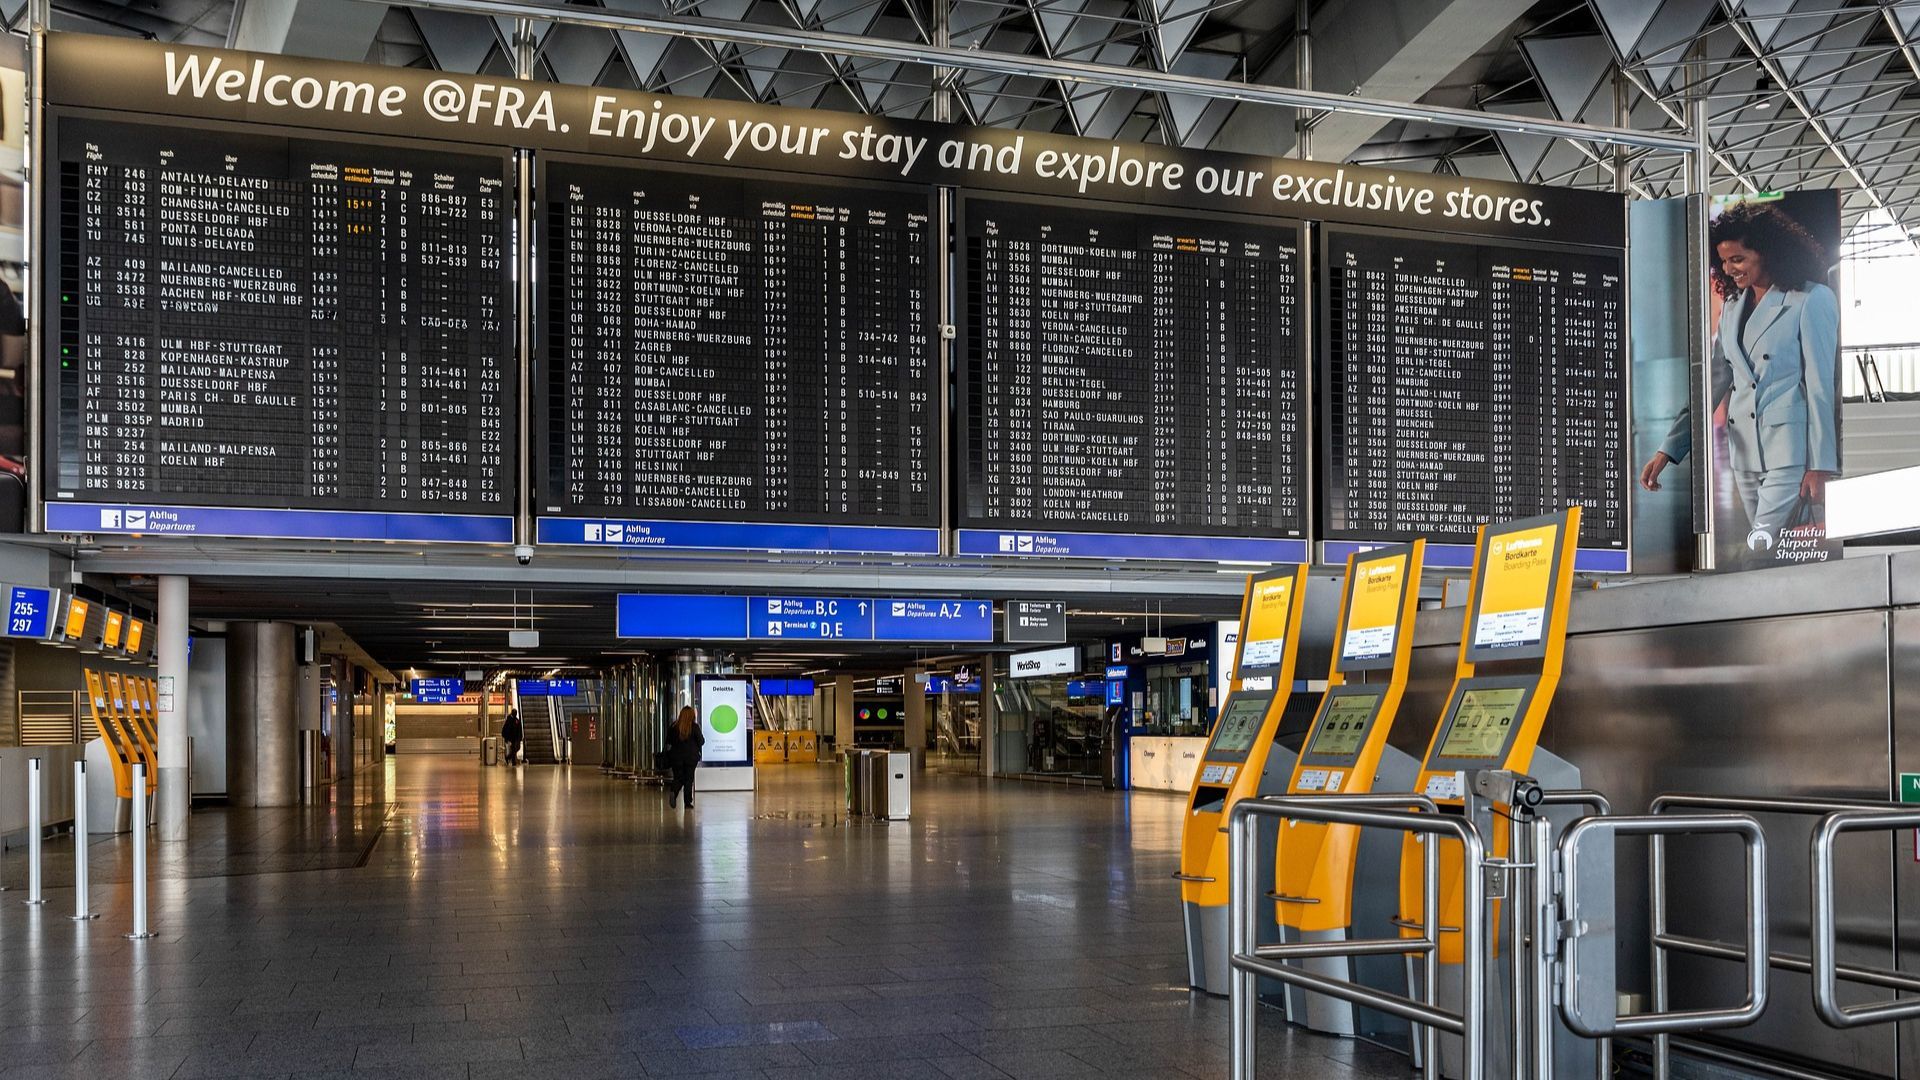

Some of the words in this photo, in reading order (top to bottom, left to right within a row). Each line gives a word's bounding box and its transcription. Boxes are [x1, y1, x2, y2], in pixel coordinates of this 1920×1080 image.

[164, 51, 407, 117] Welcome
[422, 78, 570, 134] @FRA.
[589, 95, 716, 157] Enjoy
[723, 119, 830, 161] your
[838, 125, 928, 176] stay
[937, 136, 1025, 175] and
[1034, 146, 1183, 194] explore
[1195, 165, 1264, 198] our
[1271, 169, 1435, 214] exclusive
[1443, 187, 1553, 227] stores.
[86, 143, 98, 152] Flug
[86, 152, 102, 161] Flight
[311, 172, 338, 180] scheduled
[344, 175, 372, 184] estimated
[373, 176, 395, 185] Terminal
[434, 182, 454, 190] Counter
[480, 185, 492, 193] Gate
[344, 166, 369, 175] erwartet
[372, 168, 394, 177] Terminal
[433, 173, 454, 182] Schalter
[480, 177, 502, 187] Flugsteig
[88, 165, 108, 175] FHY
[125, 168, 145, 179] 246
[161, 172, 268, 189] ANTALYA-DELAYED
[422, 193, 466, 205] 886-887
[482, 199, 493, 207] E3
[87, 178, 100, 188] AZ
[125, 182, 145, 191] 403
[161, 184, 254, 200] ROM-FIUMICINO
[422, 206, 466, 218] 719-722
[482, 211, 493, 220] B9
[87, 191, 100, 201] CZ
[125, 194, 145, 204] 332
[161, 197, 289, 216] CHANGSHA-CANCELLED
[571, 205, 582, 214] LH
[597, 207, 620, 217] 3518
[634, 211, 701, 223] DUESSELDORF
[709, 217, 725, 226] HBF
[571, 217, 582, 226] EN
[597, 219, 620, 229] 8828
[634, 222, 732, 238] VERONA-CANCELLED
[87, 218, 100, 227] S4
[125, 220, 144, 230] 561
[161, 223, 196, 234] PONTA
[205, 226, 254, 238] DELGADA
[422, 243, 466, 254] 811-813
[482, 247, 499, 257] E24
[597, 231, 620, 241] 3476
[634, 234, 750, 251] NUERNBERG-WUERZBURG
[87, 231, 100, 240] TU
[125, 233, 144, 243] 745
[161, 236, 253, 251] TUNIS-DELAYED
[422, 255, 466, 266] 537-539
[482, 260, 499, 269] B47
[987, 240, 997, 248] LH
[1009, 241, 1029, 250] 3628
[1042, 244, 1116, 257] DORTMUND-KOELN
[1122, 251, 1136, 259] HBF
[1395, 274, 1464, 287] TURIN-CANCELLED
[1347, 280, 1356, 288] LH
[1371, 282, 1384, 290] 824
[1395, 285, 1478, 298] KOPENHAGEN-KASTRUP
[571, 314, 582, 322] QR
[604, 316, 620, 325] 068
[635, 318, 696, 329] DOHA-HAMAD
[1348, 322, 1356, 330] LH
[1368, 324, 1385, 332] 1234
[1395, 326, 1414, 334] WIEN
[87, 387, 100, 396] AF
[119, 389, 144, 398] 1219
[161, 391, 196, 401] PARIS
[234, 394, 246, 403] DE
[255, 395, 295, 406] GAULLE
[572, 399, 583, 407] AT
[604, 400, 620, 408] 811
[635, 401, 751, 415] CASABLANC-CANCELLED
[1396, 409, 1432, 418] BRUESSEL
[87, 413, 108, 423] PLM
[125, 415, 152, 424] 935P
[161, 416, 203, 427] MADRID
[988, 408, 998, 416] LA
[1010, 409, 1030, 417] 8071
[1043, 411, 1058, 419] SAO
[1065, 412, 1143, 423] PAULO-GUARULHOS
[988, 419, 998, 427] ZB
[1011, 420, 1030, 428] 6014
[1043, 422, 1074, 431] TIRANA
[572, 459, 583, 467] AY
[599, 460, 621, 469] 1416
[635, 461, 682, 471] HELSINKI
[989, 486, 998, 494] LH
[1016, 487, 1031, 496] 900
[1044, 489, 1123, 499] LONDON-HEATHROW
[572, 495, 583, 503] TP
[605, 496, 621, 505] 579
[636, 497, 745, 509] LISSABON-CANCELLED
[149, 510, 178, 522] Abflug
[149, 521, 196, 531] Departures
[625, 524, 651, 535] Abflug
[1375, 522, 1386, 530] 107
[1397, 523, 1411, 531] NEW
[625, 534, 666, 544] Departures
[1035, 536, 1057, 545] Abflug
[1777, 538, 1819, 551] Airport
[1035, 545, 1070, 554] Departures
[1505, 550, 1538, 561] Bordkarte
[1775, 548, 1829, 562] Shopping
[1503, 560, 1531, 572] Boarding
[1367, 575, 1392, 584] Bordkarte
[13, 601, 39, 616] 255-
[783, 600, 803, 608] Abflug
[815, 600, 838, 617] B,C
[907, 602, 926, 610] Abflug
[939, 603, 962, 619] A,Z
[783, 607, 814, 616] Departures
[907, 610, 936, 618] Departures
[12, 618, 32, 632] 297
[783, 621, 809, 629] Terminal
[820, 622, 843, 638] D,E
